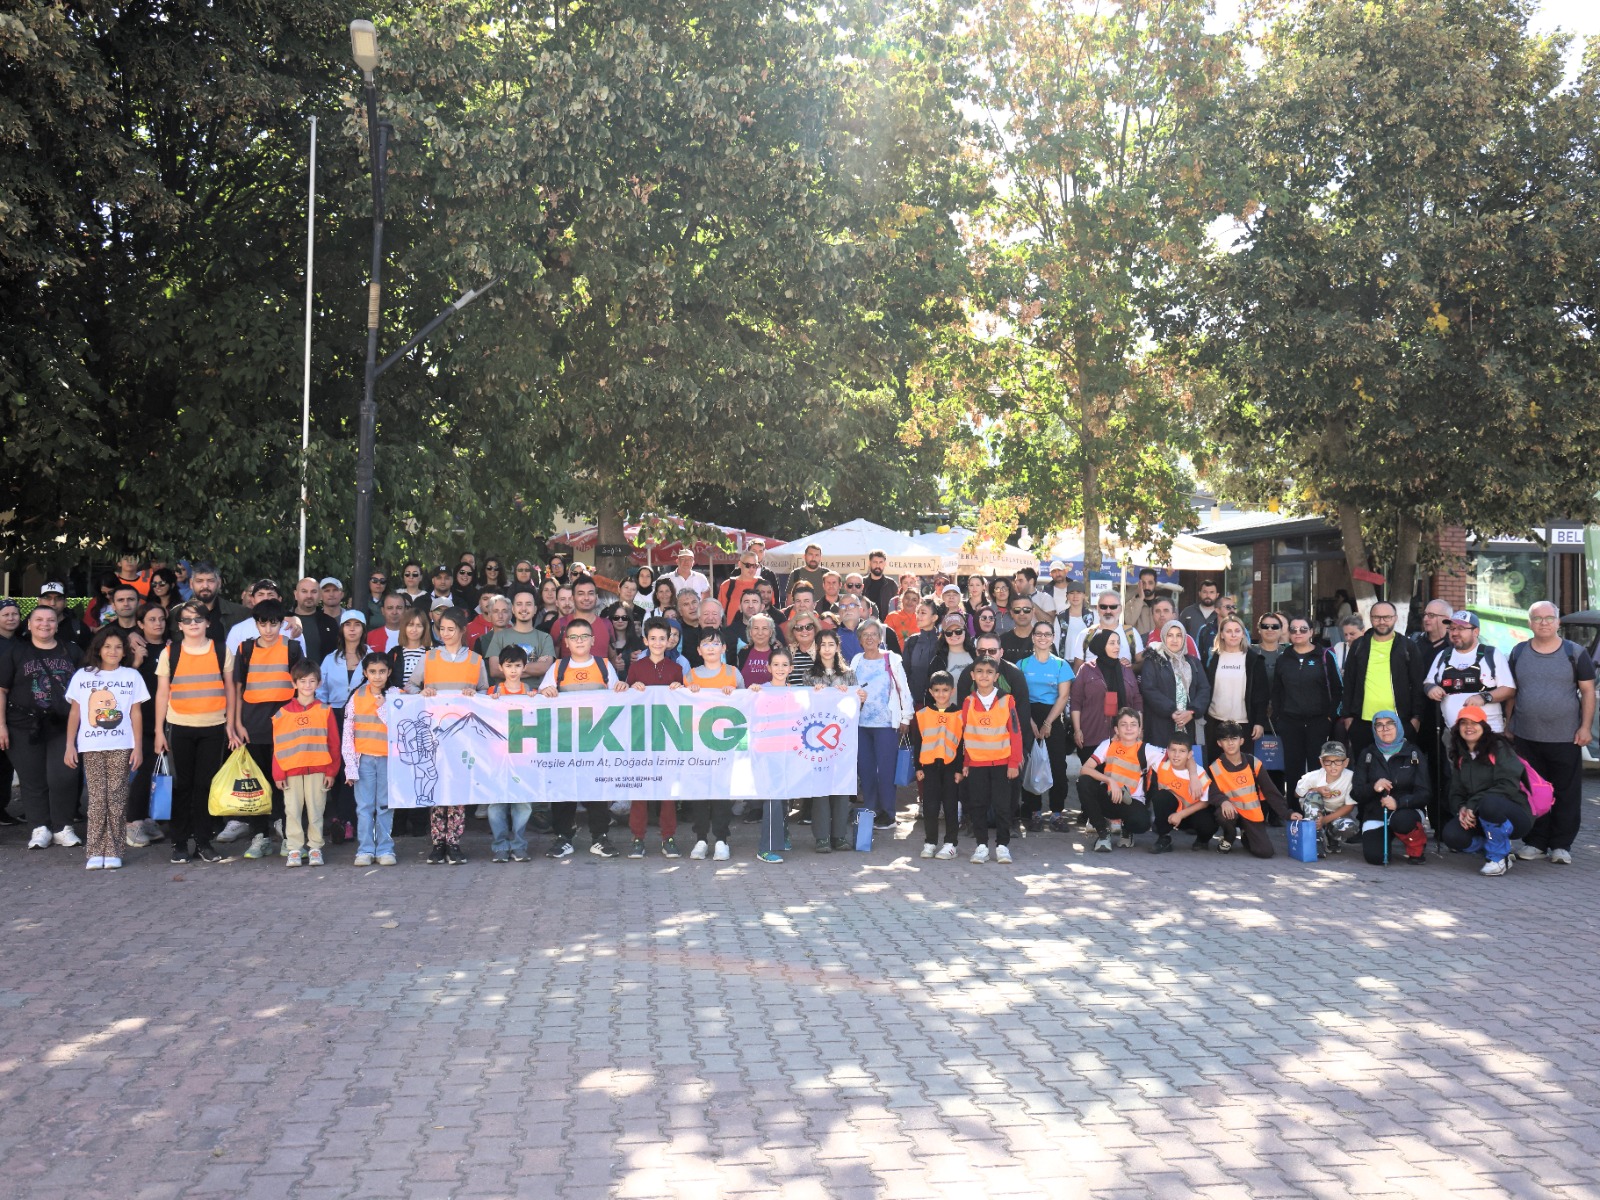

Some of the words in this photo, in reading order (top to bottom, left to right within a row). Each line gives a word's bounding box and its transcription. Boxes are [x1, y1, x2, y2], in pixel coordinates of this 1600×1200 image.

[1557, 531, 1585, 543] BEL
[820, 561, 861, 569] ELATERIA
[79, 680, 105, 689] KEEP
[106, 680, 134, 688] CALM
[84, 729, 109, 738] CAPY
[507, 704, 748, 753] HIKING
[568, 758, 595, 767] Adım
[614, 757, 654, 768] Doğada
[656, 755, 685, 766] İzimiz
